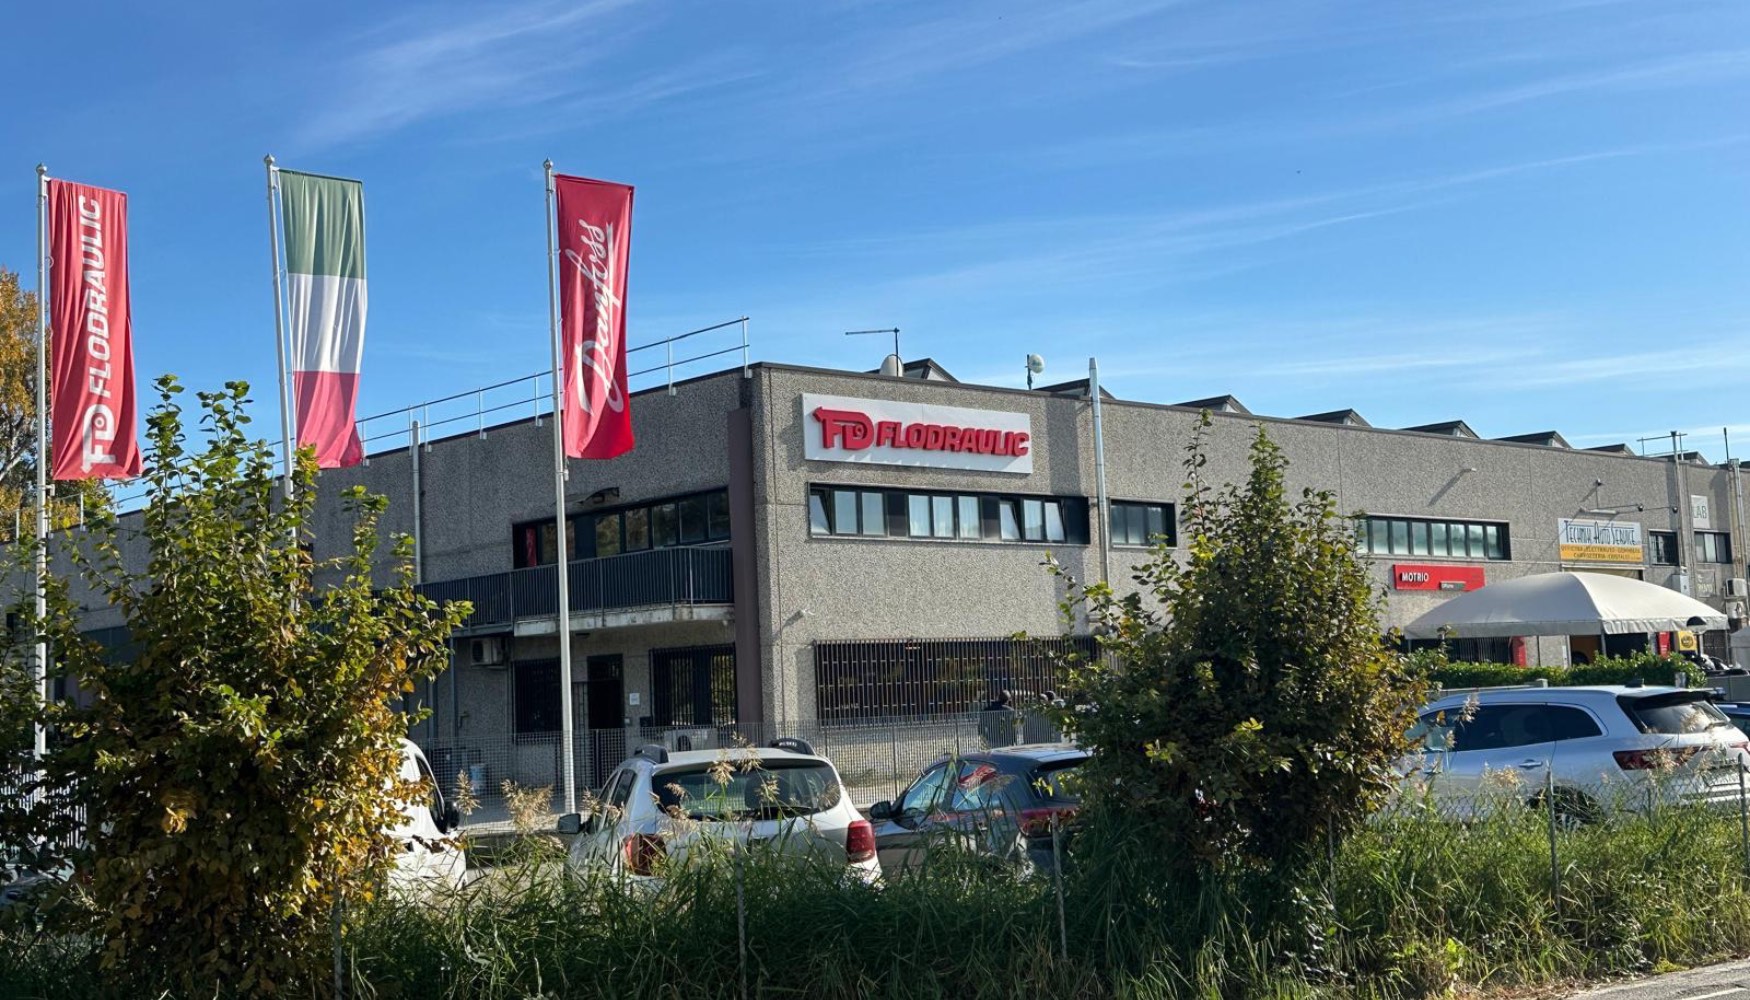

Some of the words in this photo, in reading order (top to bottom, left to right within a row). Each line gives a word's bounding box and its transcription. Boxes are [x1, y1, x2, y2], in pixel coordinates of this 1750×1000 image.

[79, 195, 111, 397] FLODRAULIC
[565, 219, 624, 416] Danfoss
[876, 421, 1029, 456] FLODRAULIC
[1400, 572, 1429, 582] MOTRIO
